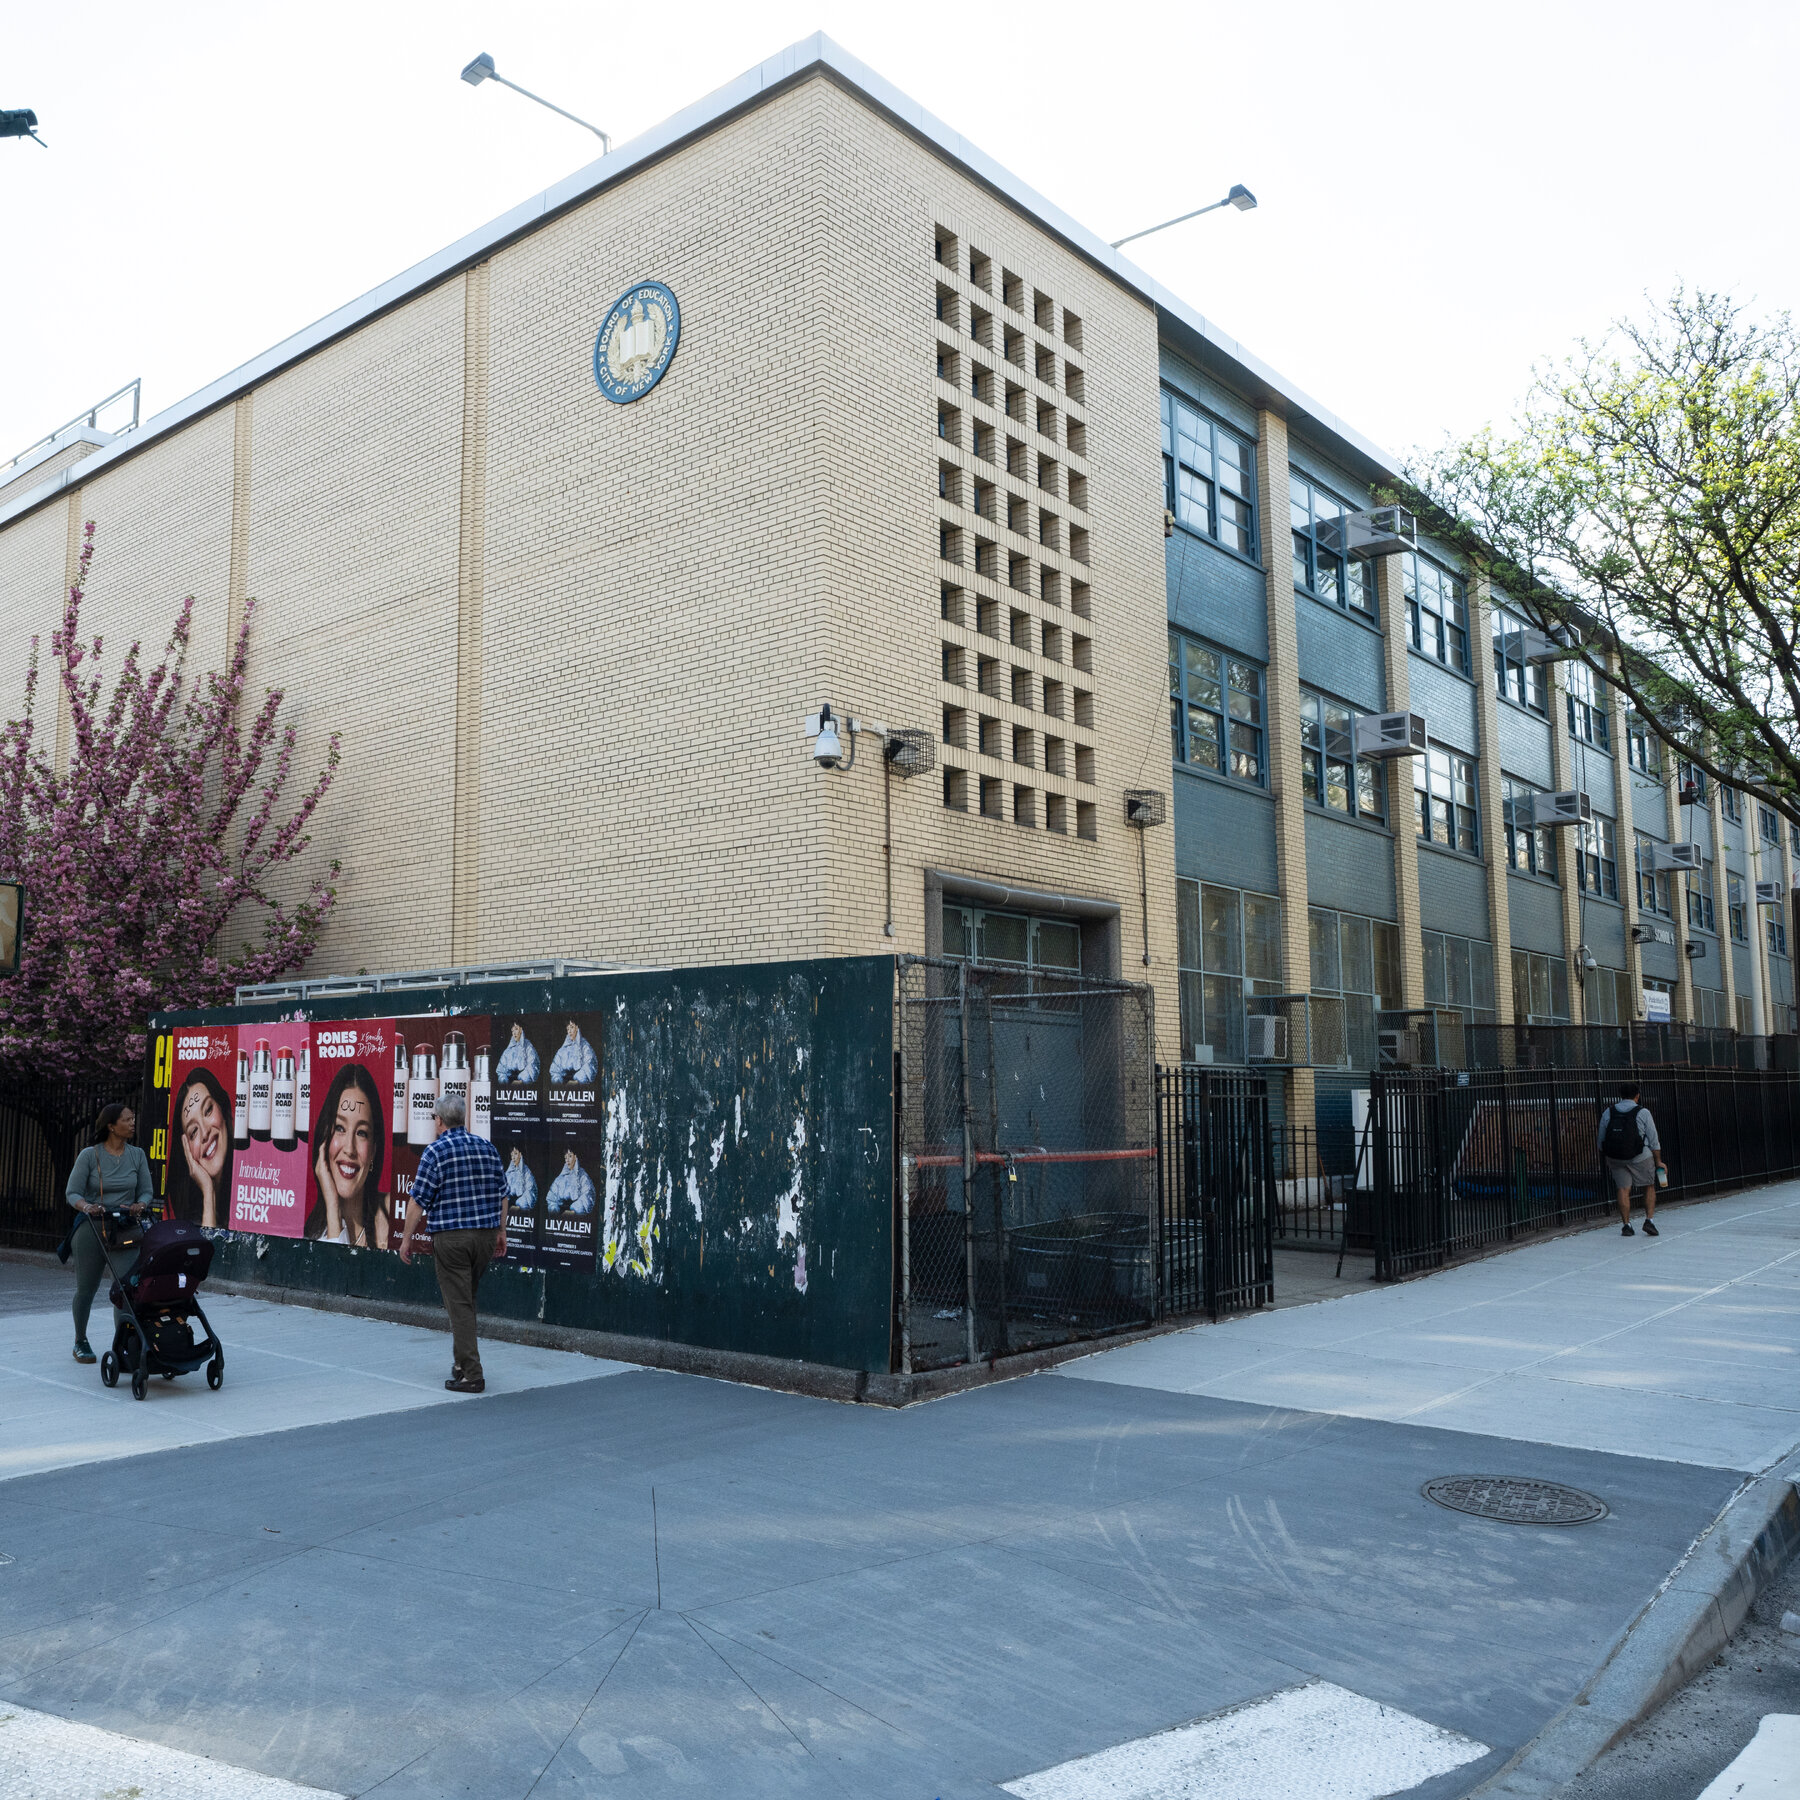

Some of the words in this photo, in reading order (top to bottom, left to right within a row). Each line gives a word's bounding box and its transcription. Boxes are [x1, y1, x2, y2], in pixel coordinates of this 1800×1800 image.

[600, 312, 619, 352] BOARD
[622, 295, 634, 309] OF
[638, 289, 674, 321] EDUCATION
[600, 367, 615, 389] CITY
[614, 385, 629, 396] OF
[632, 373, 653, 394] NEW
[655, 337, 672, 370] YORK
[177, 1035, 209, 1049] JONES
[316, 1030, 358, 1045] JONES
[178, 1048, 208, 1060] ROAD
[318, 1045, 356, 1058] ROAD
[153, 1035, 173, 1088] CA
[394, 1082, 406, 1090] NES
[444, 1082, 467, 1090] JONES
[236, 1093, 247, 1101] NES
[274, 1092, 293, 1100] JONES
[394, 1090, 405, 1098] AD
[412, 1092, 435, 1101] JONES
[474, 1095, 491, 1103] JON
[496, 1090, 512, 1101] LILY
[512, 1090, 538, 1101] ALLEN
[549, 1090, 567, 1102] LILY
[567, 1090, 595, 1103] ALLEN
[183, 1092, 200, 1118] ICE
[235, 1100, 246, 1108] OAD
[275, 1099, 292, 1107] ROAD
[340, 1099, 365, 1113] OUT
[412, 1101, 434, 1109] ROAD
[475, 1103, 491, 1112] ROA
[150, 1128, 166, 1160] JEL
[238, 1159, 281, 1186] Introducing
[237, 1184, 295, 1208] BLUSHING
[235, 1203, 270, 1224] STICK
[509, 1215, 535, 1229] ALLEN
[545, 1218, 563, 1231] LILY
[562, 1220, 592, 1235] ALLEN
